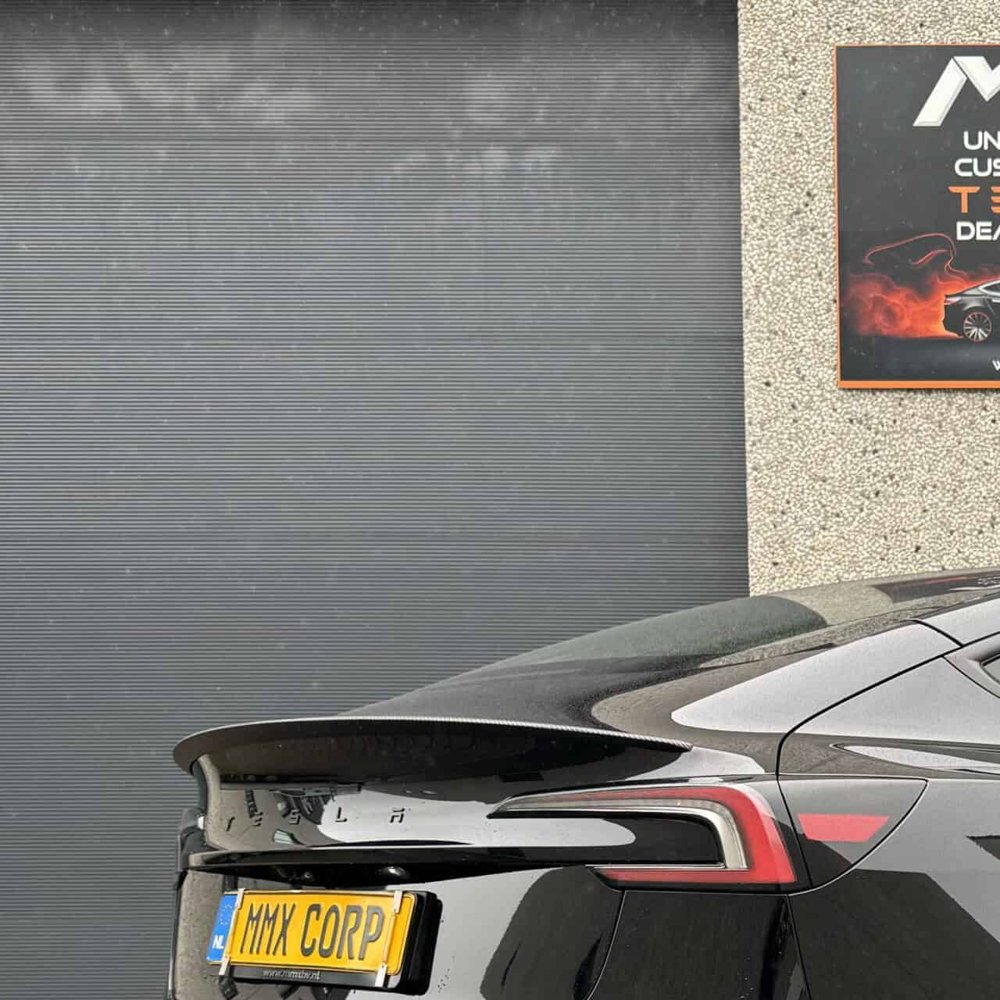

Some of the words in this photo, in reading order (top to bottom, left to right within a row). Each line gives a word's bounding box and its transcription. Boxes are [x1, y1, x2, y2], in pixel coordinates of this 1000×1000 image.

[212, 935, 225, 949] NL
[240, 903, 296, 956] MMX
[300, 904, 384, 960] CORP
